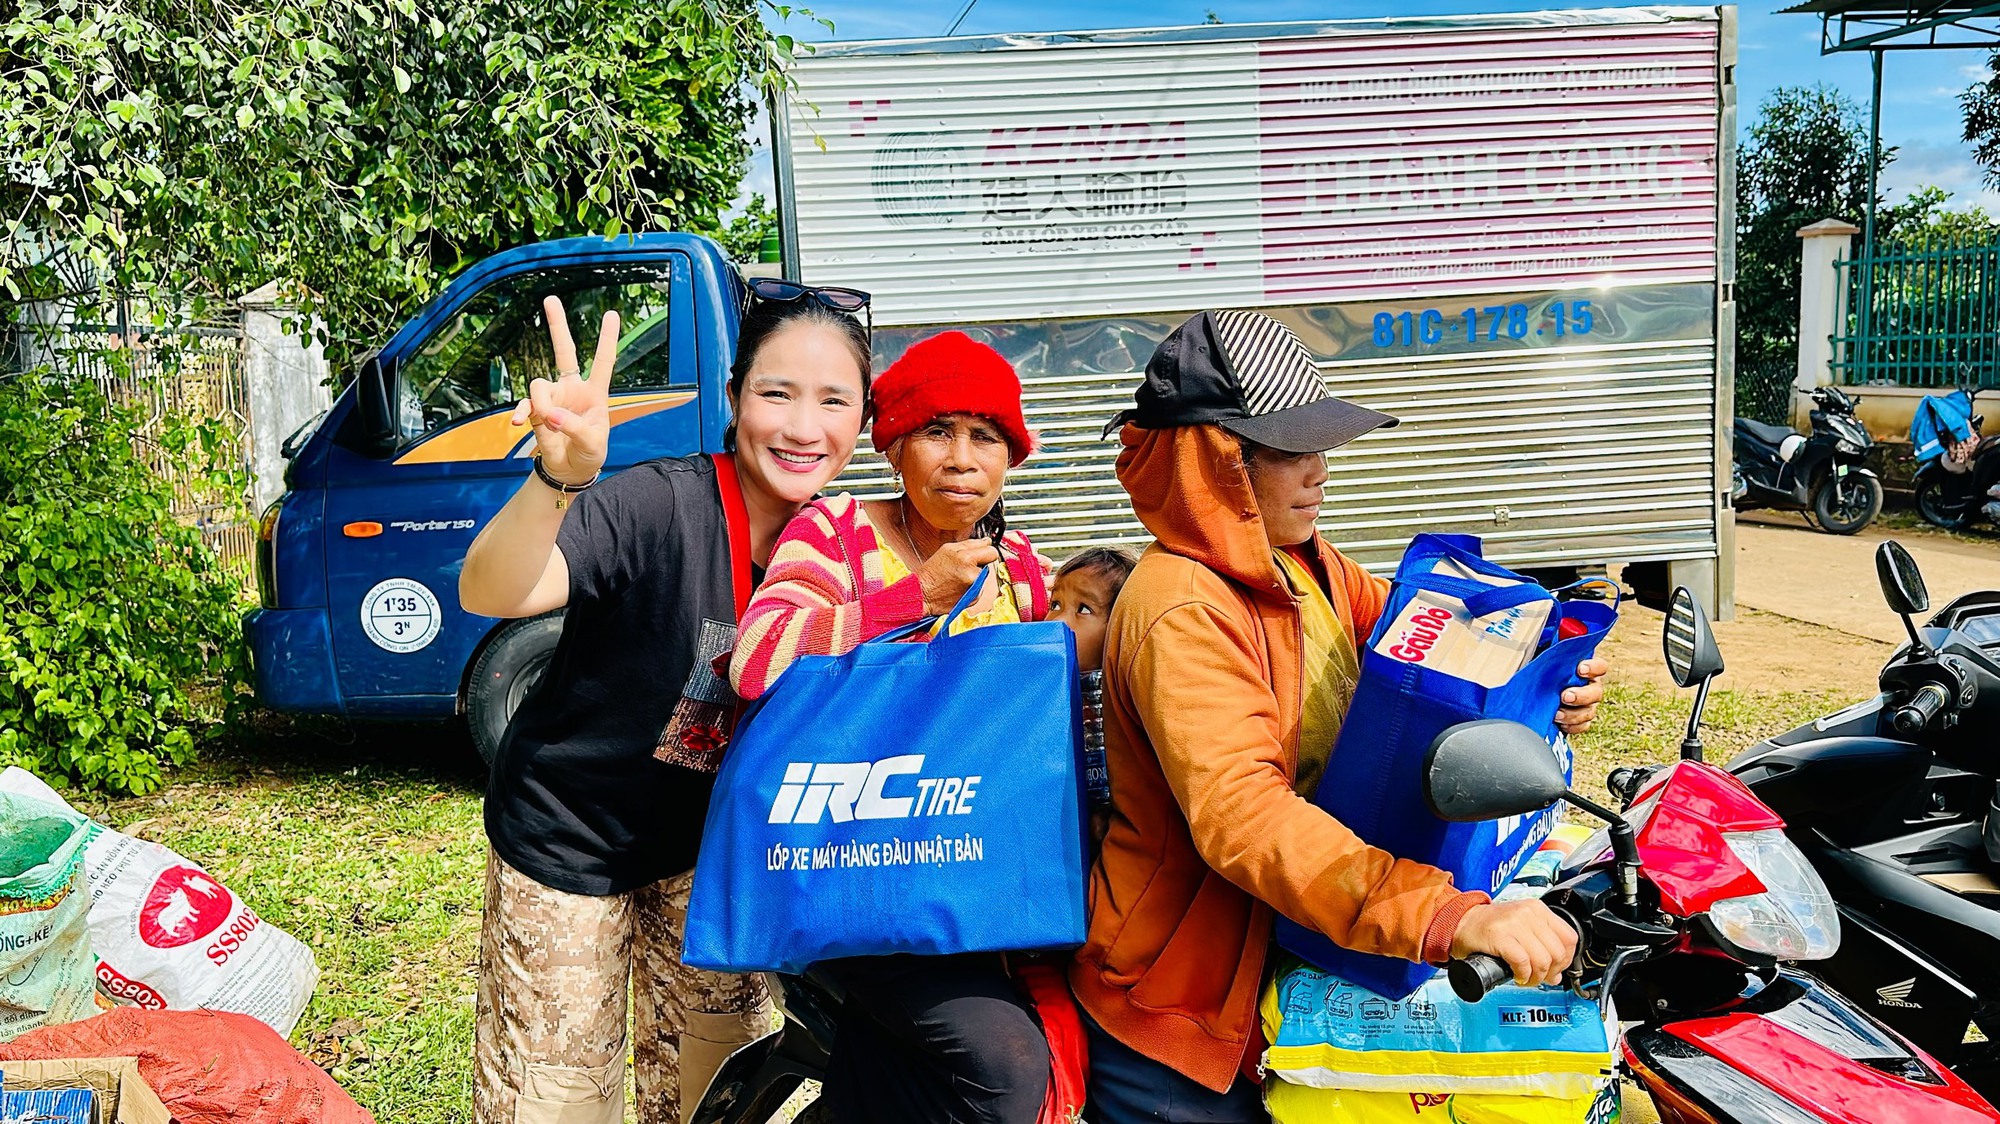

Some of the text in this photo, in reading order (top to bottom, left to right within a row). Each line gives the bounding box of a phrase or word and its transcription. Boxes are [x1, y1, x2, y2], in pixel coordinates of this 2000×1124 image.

[981, 121, 1186, 167] KENDA
[1292, 120, 1684, 216] THÀNH CÔNG
[402, 520, 452, 532] Porter
[452, 519, 475, 529] 150
[913, 776, 982, 818] TIRE
[767, 833, 984, 871] LỐP XE MÁY HÀNG ĐẦU NHẬT BẢN
[206, 906, 260, 967] SS802
[1502, 1012, 1526, 1023] KLT:
[1877, 999, 1923, 1009] HONDA
